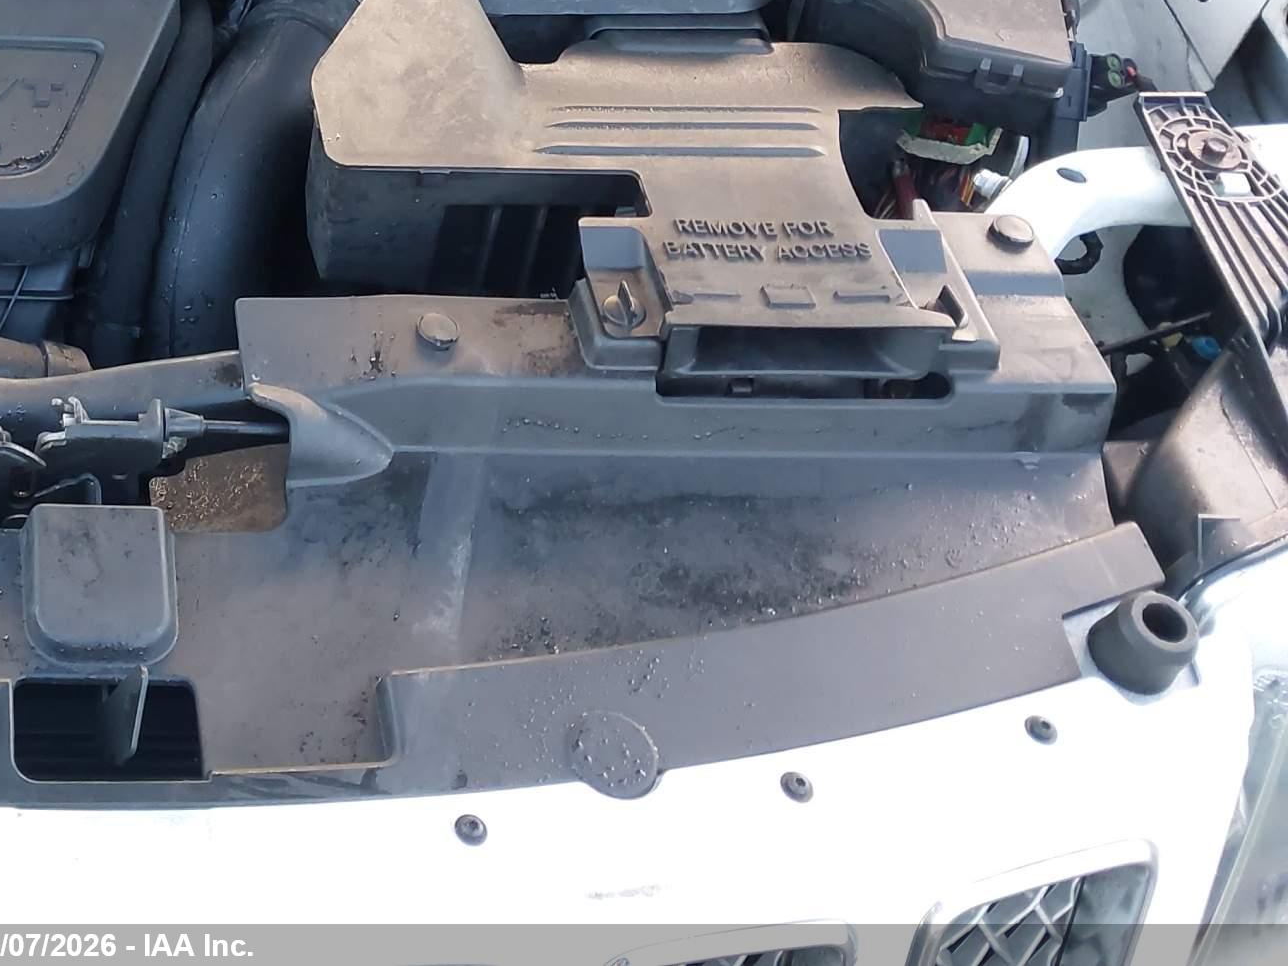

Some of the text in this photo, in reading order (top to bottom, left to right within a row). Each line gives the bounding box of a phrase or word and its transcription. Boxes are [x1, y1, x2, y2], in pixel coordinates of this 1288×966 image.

[674, 218, 835, 239] REMOVE FOR
[663, 241, 872, 262] BATTERY ACCESS
